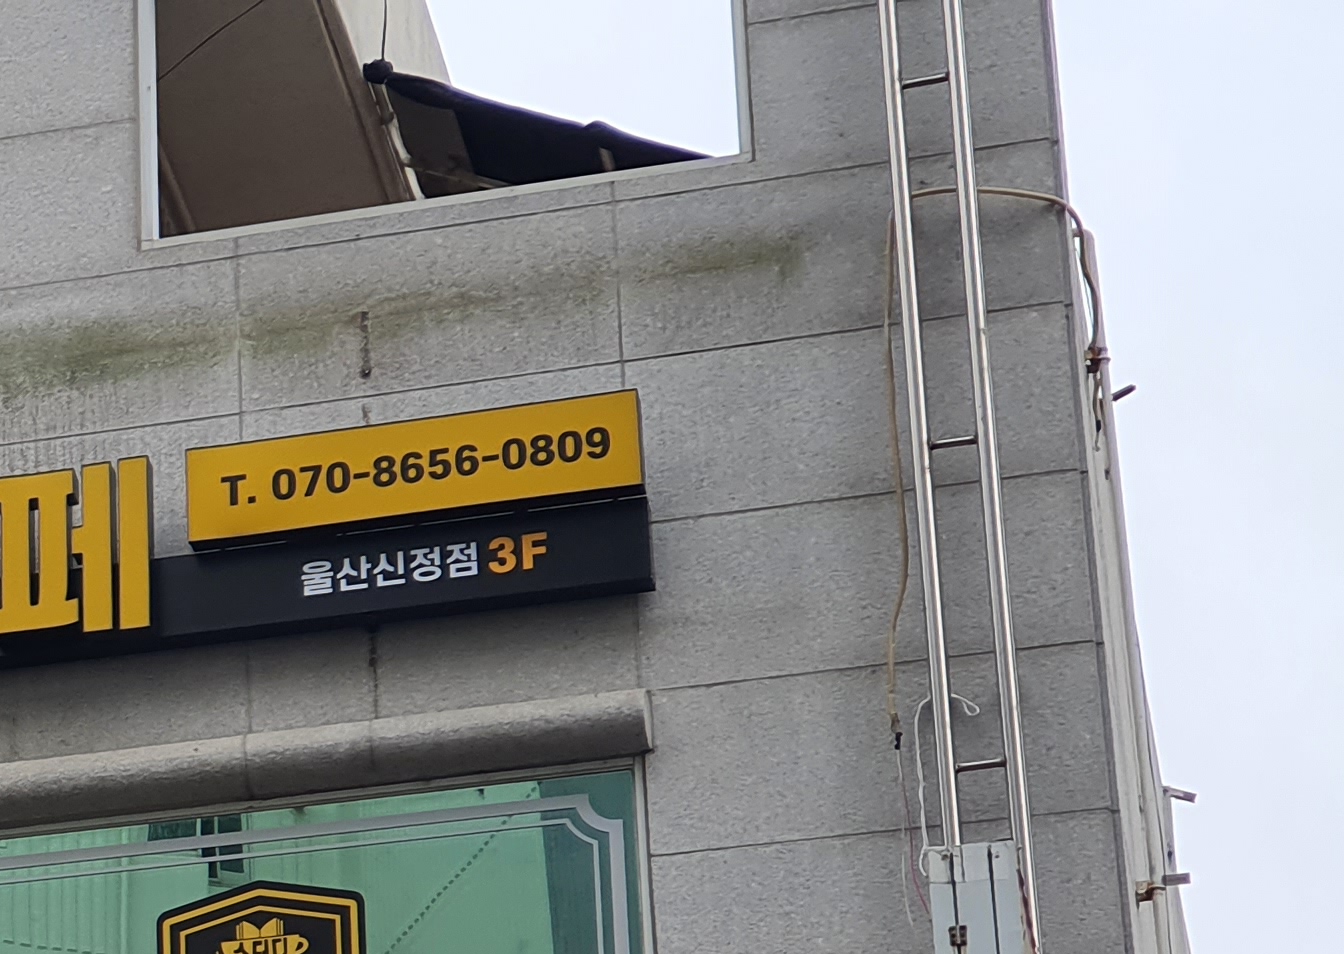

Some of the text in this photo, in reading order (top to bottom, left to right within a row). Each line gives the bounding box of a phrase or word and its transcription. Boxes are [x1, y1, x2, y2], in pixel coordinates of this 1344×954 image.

[221, 426, 611, 507] T. 070-8656-0809
[300, 531, 548, 597] 울산신정점 3F
